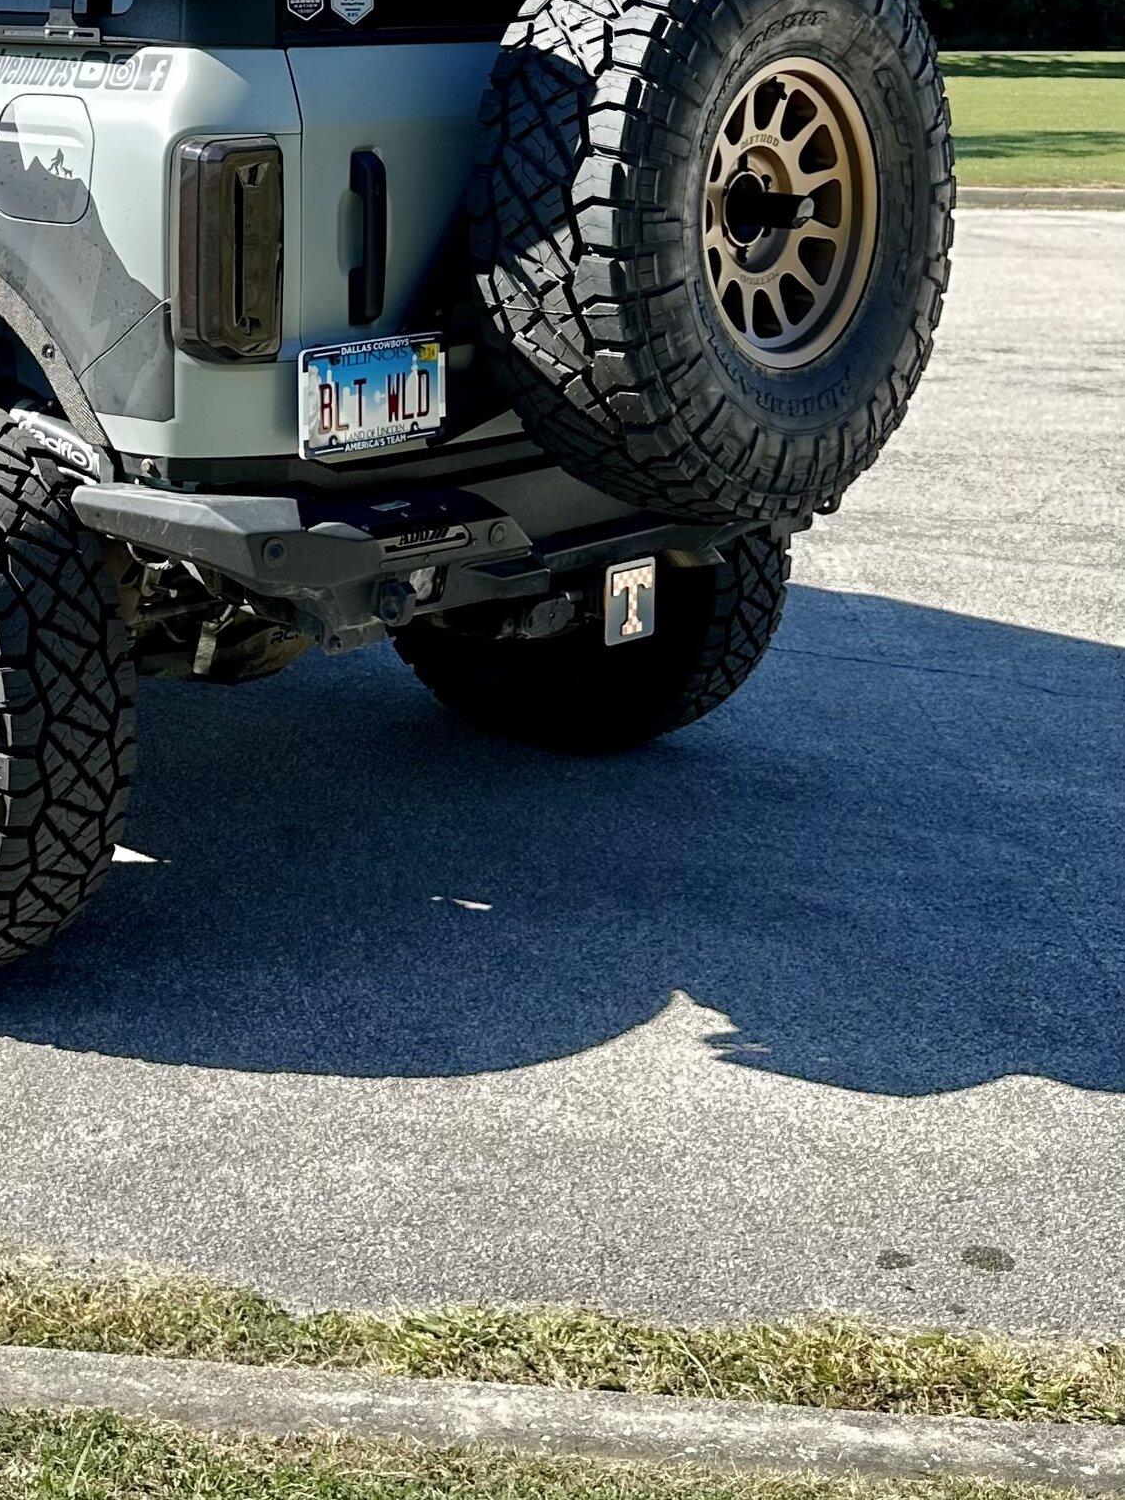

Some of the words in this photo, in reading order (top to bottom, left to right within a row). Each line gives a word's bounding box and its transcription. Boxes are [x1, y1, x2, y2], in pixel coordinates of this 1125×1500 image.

[341, 343, 372, 355] DALLAS
[373, 338, 410, 351] COWBOYS
[341, 349, 408, 368] ILLINOIS
[387, 369, 430, 422] WLD
[345, 429, 365, 442] LAND
[377, 423, 406, 437] LINCOLN
[345, 438, 385, 451] AMERICA'S
[387, 434, 407, 445] TEAM
[613, 565, 653, 636] T
